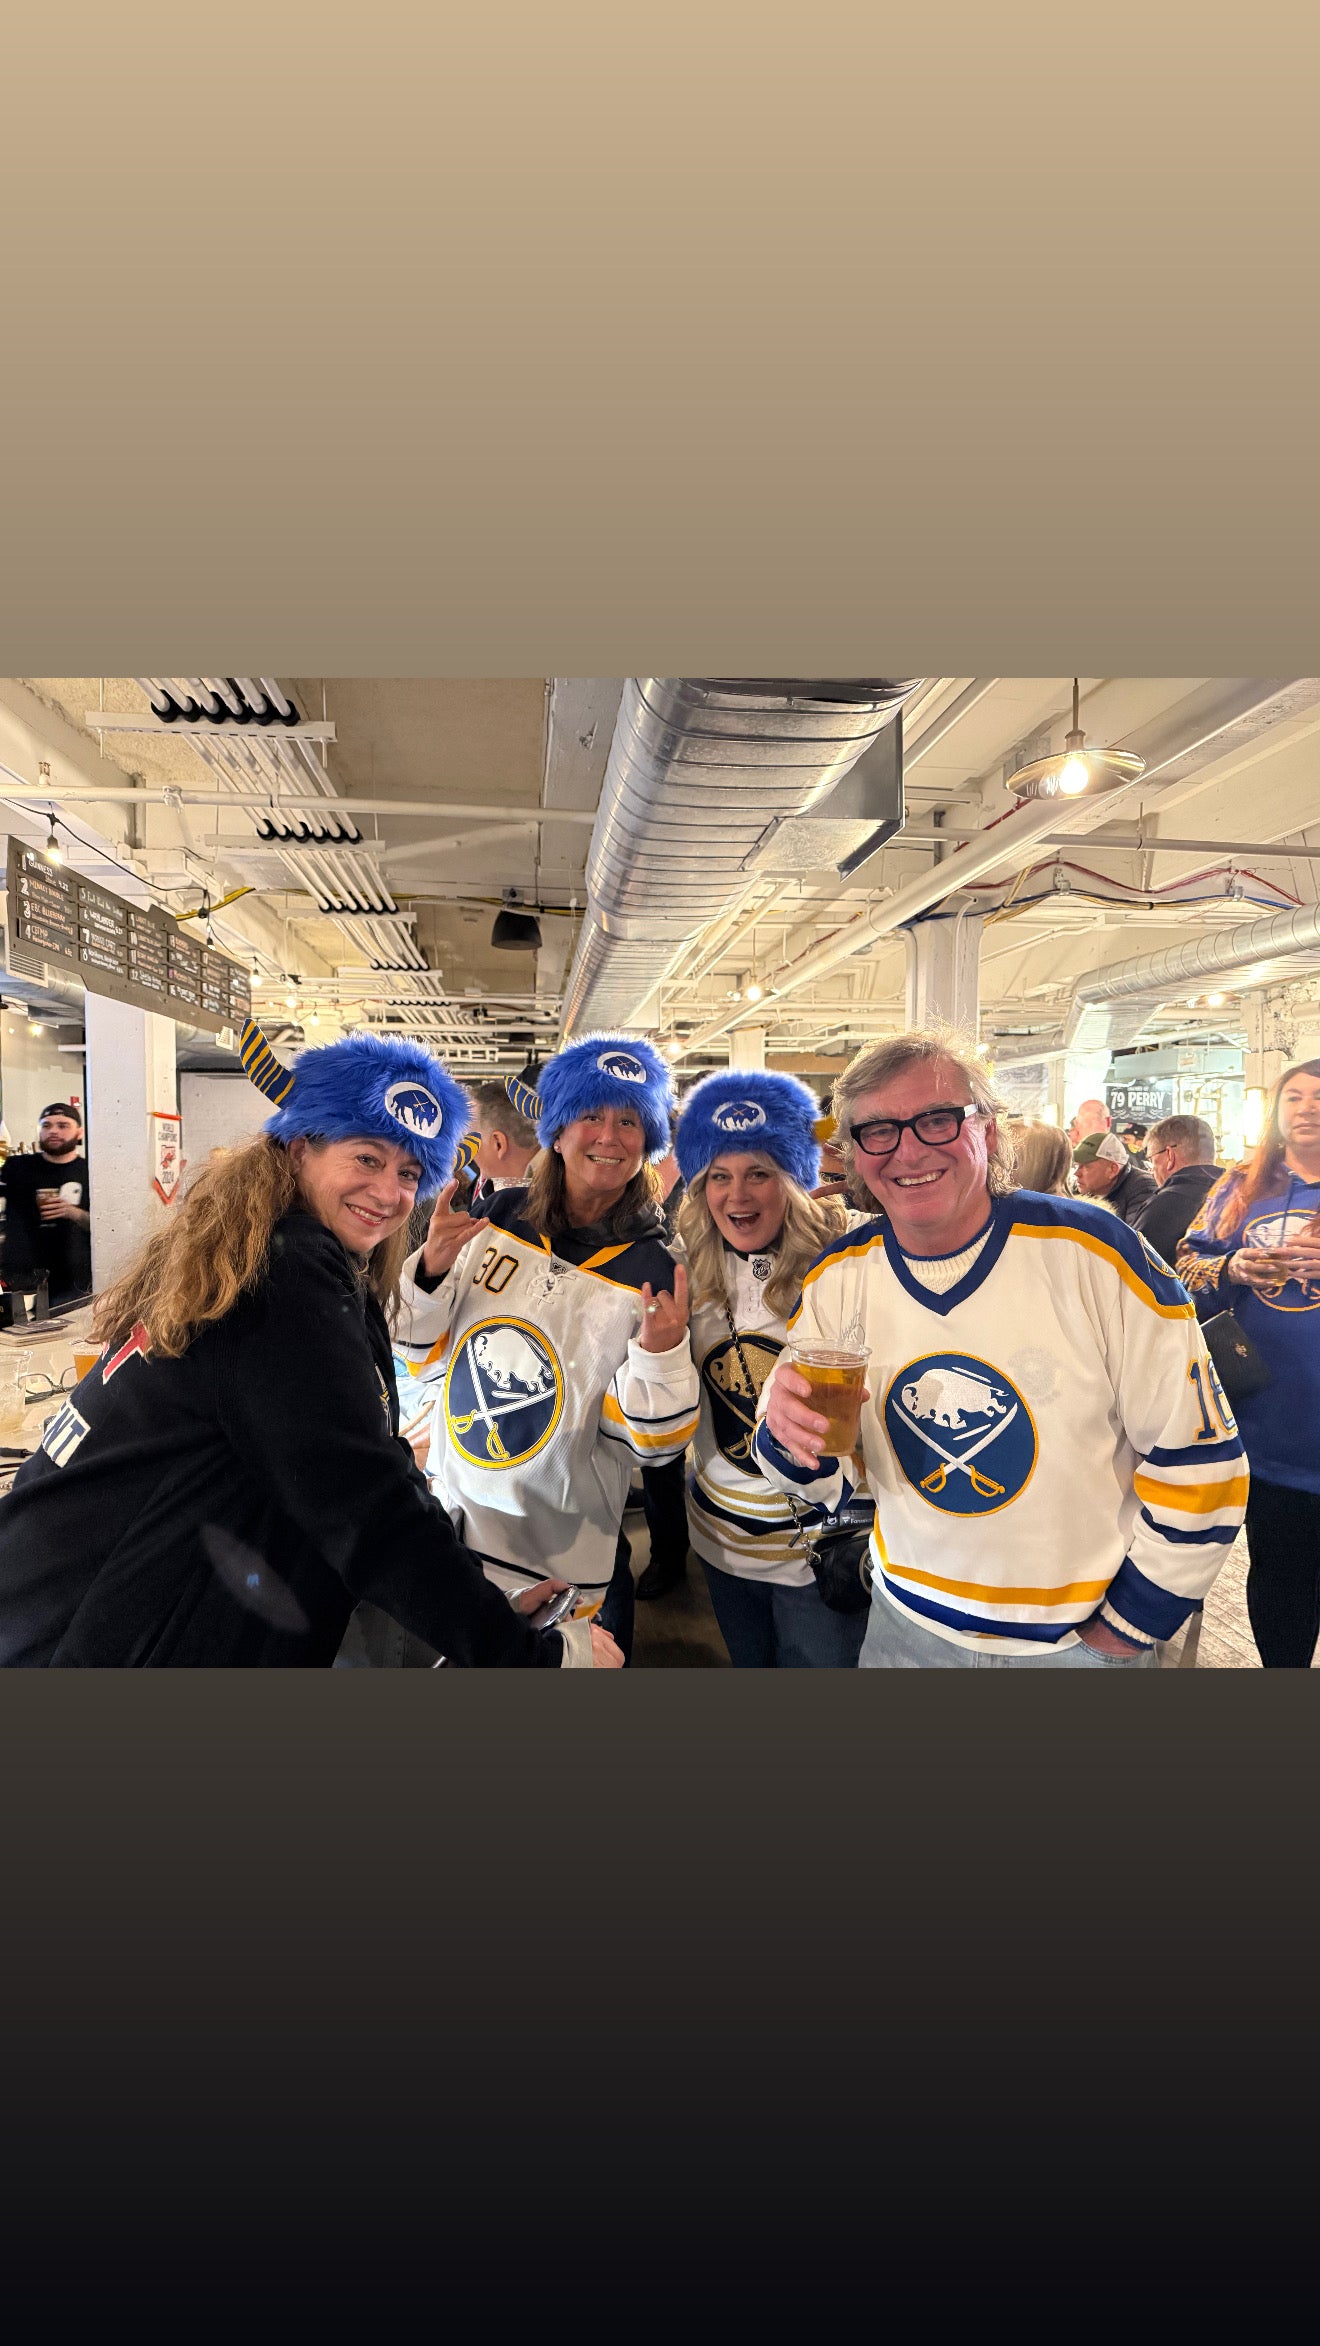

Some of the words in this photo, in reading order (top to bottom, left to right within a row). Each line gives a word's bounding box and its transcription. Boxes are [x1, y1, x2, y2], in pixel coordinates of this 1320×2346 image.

[28, 859, 53, 877] GUINNESS
[20, 877, 30, 897] 2
[23, 900, 31, 919] 3
[25, 924, 31, 939] 4
[82, 928, 90, 944] 7
[1110, 1091, 1125, 1110] 79
[1127, 1091, 1166, 1110] PERRY
[472, 1246, 519, 1295] 30
[42, 1398, 91, 1468] NT
